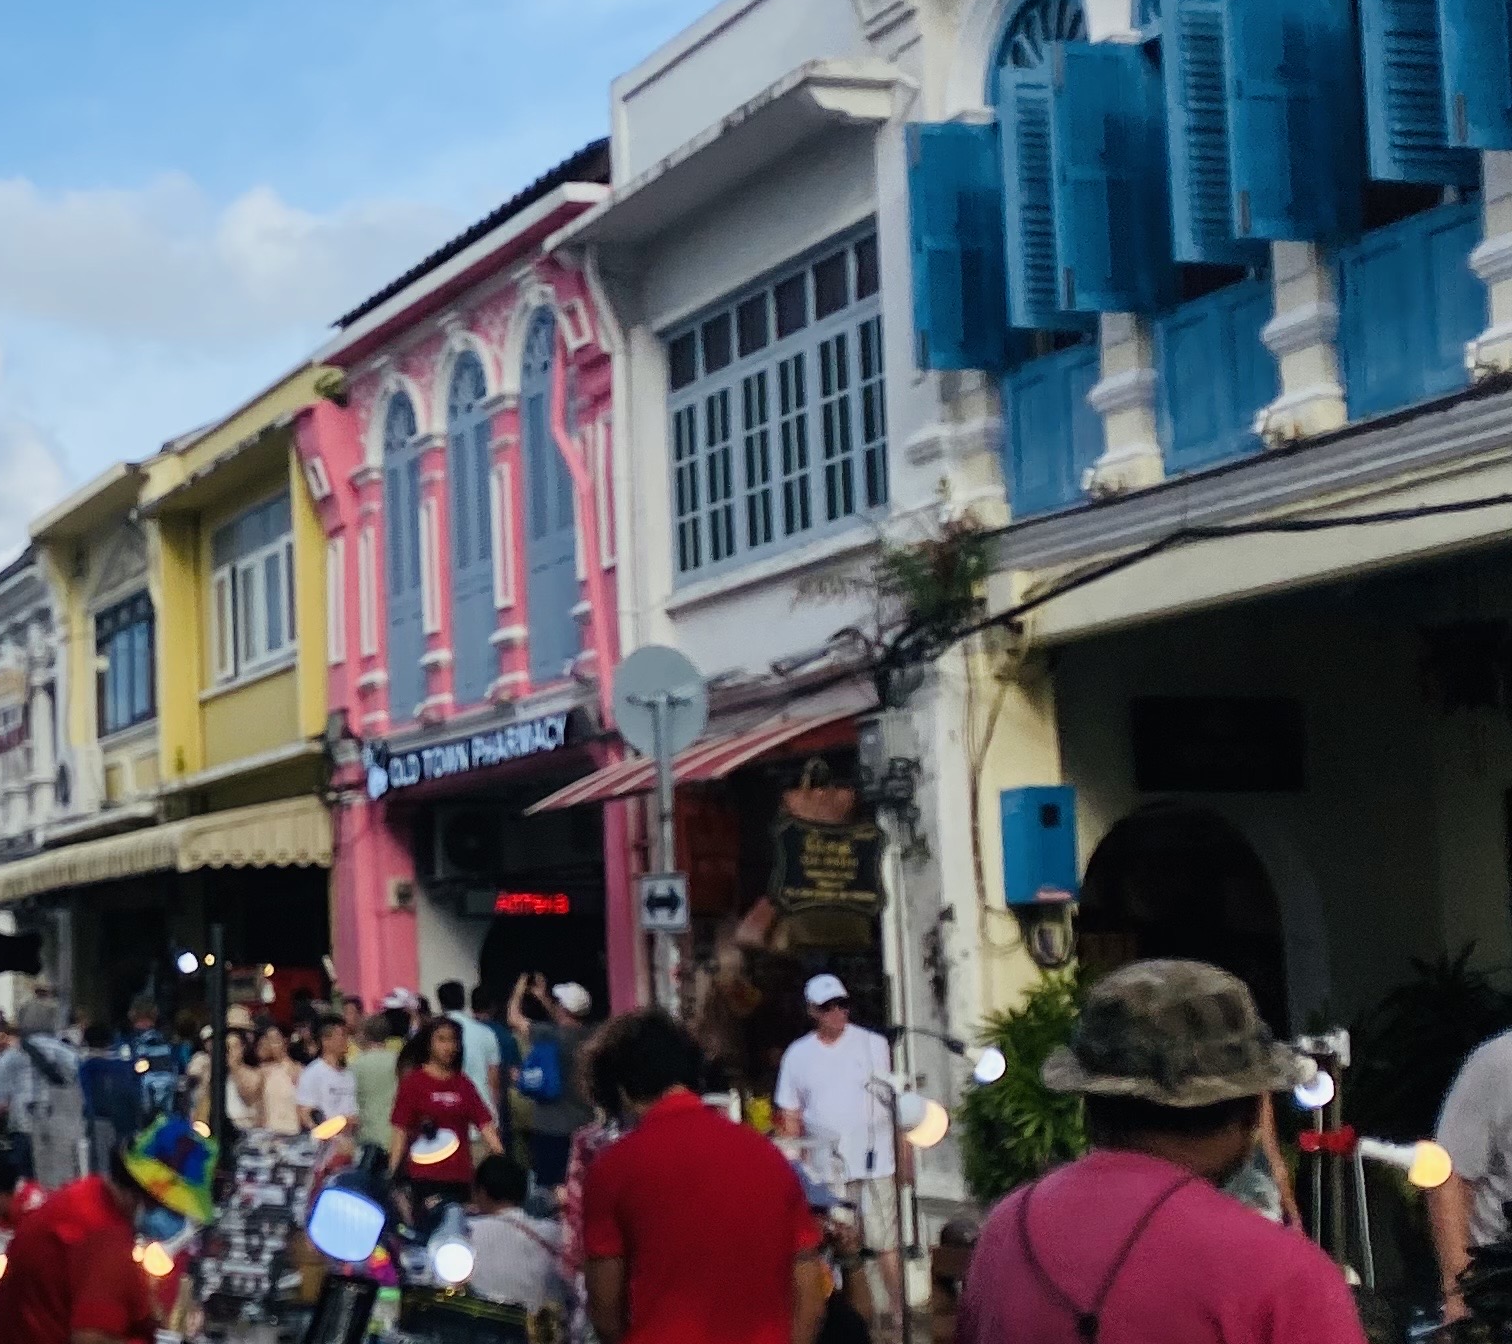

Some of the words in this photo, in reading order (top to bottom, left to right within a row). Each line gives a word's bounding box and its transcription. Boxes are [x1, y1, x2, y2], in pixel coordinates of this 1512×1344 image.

[389, 755, 420, 788] OLD
[422, 742, 469, 779] TOWN
[471, 713, 567, 768] PHARMACY
